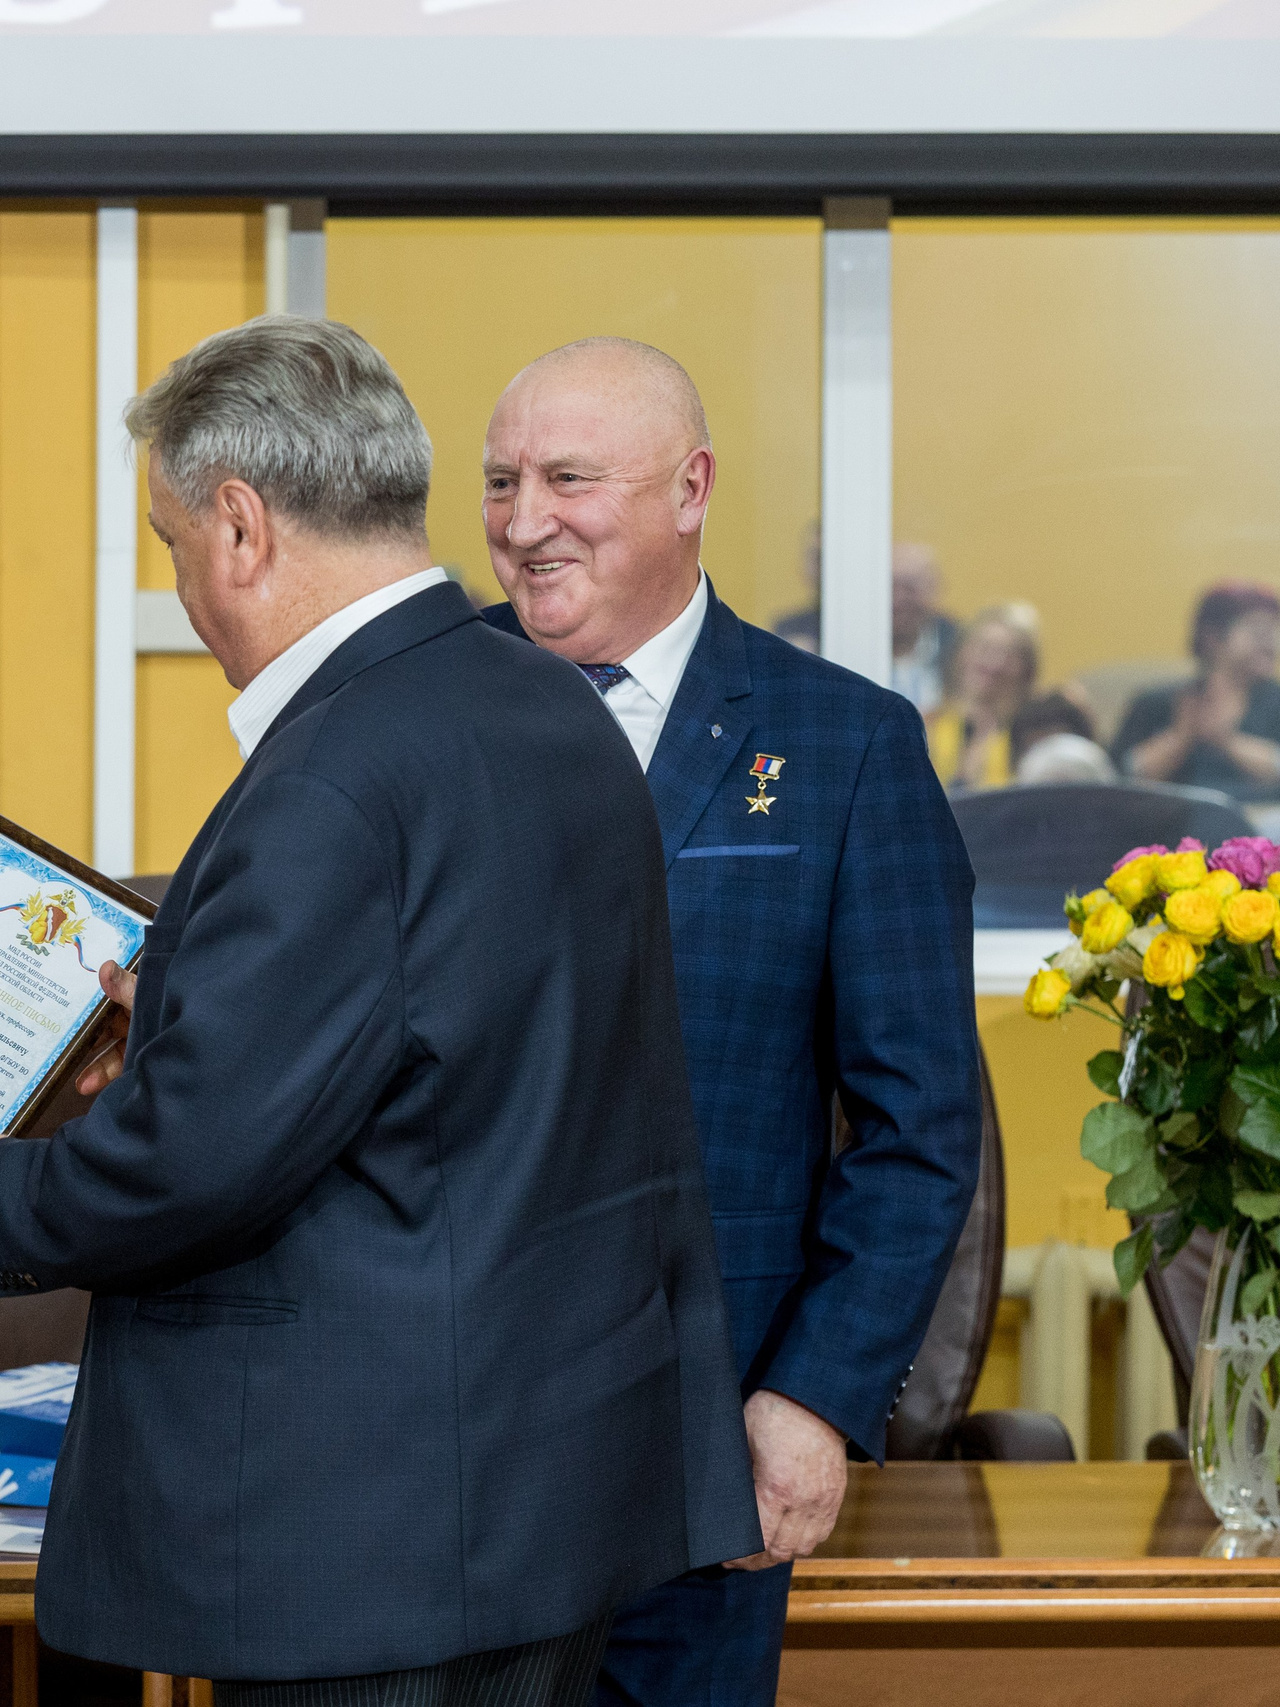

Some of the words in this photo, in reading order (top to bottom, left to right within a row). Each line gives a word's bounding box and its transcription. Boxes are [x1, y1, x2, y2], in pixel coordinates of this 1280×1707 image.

[6, 943, 22, 956] МВД
[18, 951, 43, 969] РОССИИ
[1, 962, 40, 989] РОССИЙСКОЙ
[36, 984, 71, 1008] ФЕДЕРАЦИИ
[17, 983, 45, 1003] ОБЛАСТИ
[25, 966, 70, 996] МИНИСТЕРСТВА
[3, 1014, 37, 1039] профессору
[21, 1005, 63, 1035] ПИСЬМО
[17, 1065, 30, 1076] ВО
